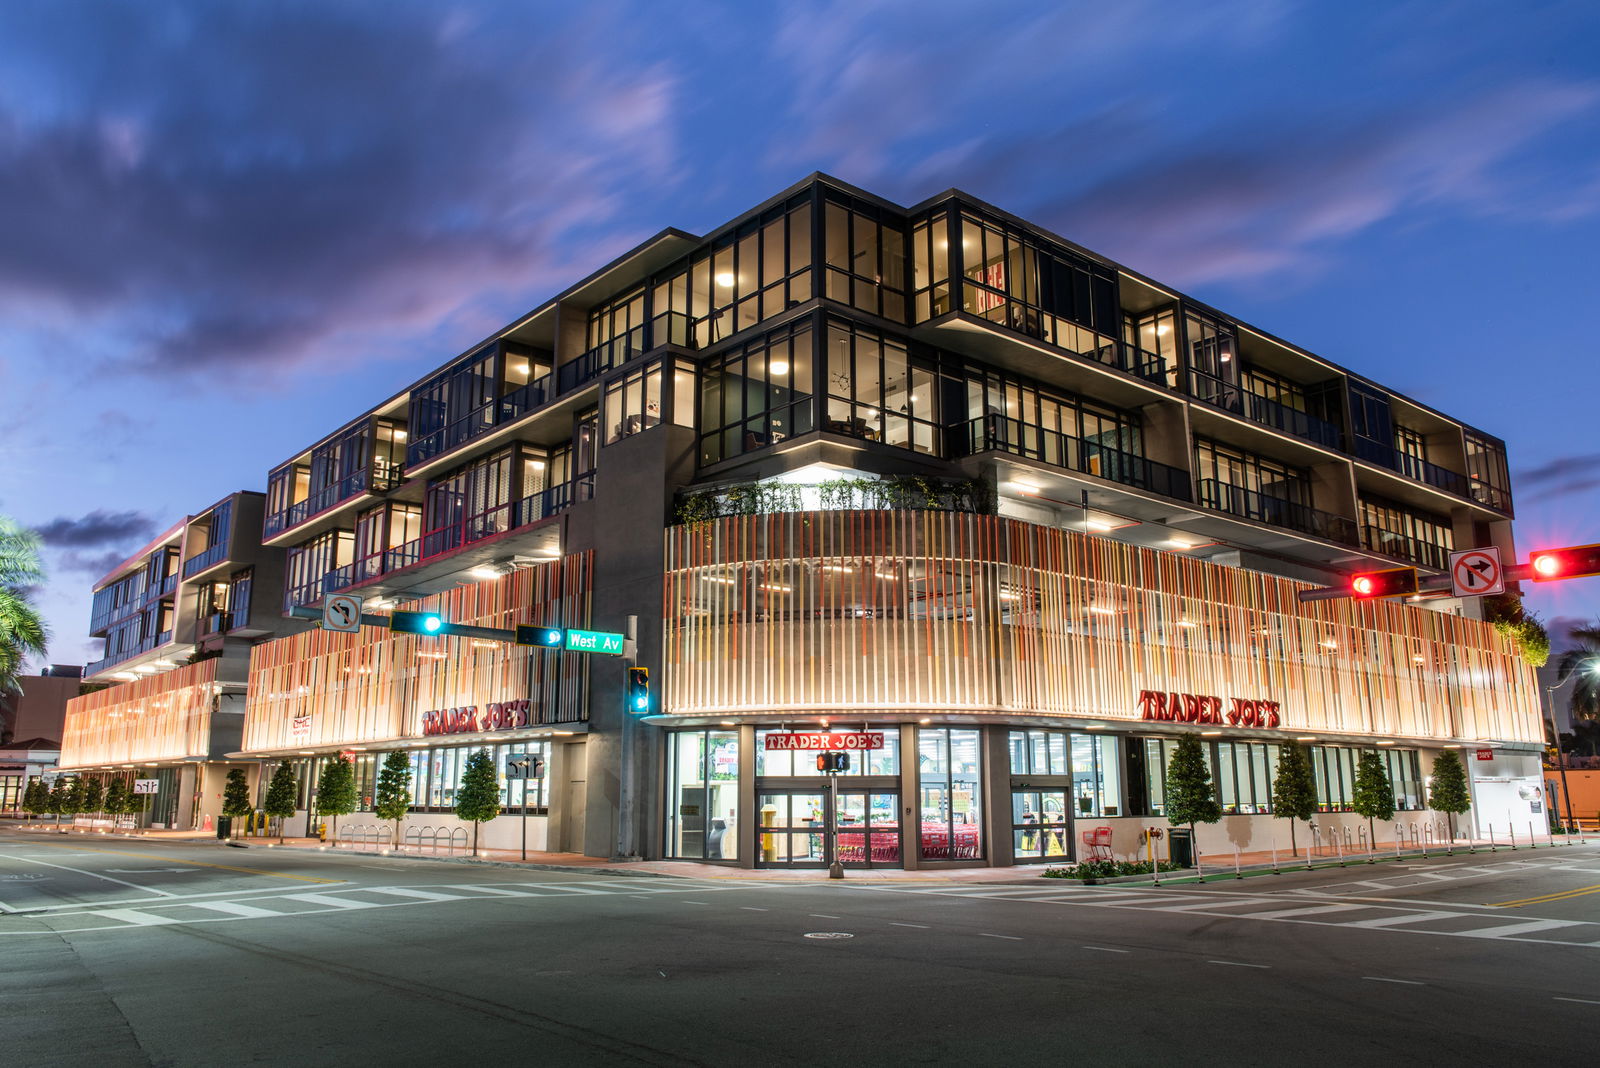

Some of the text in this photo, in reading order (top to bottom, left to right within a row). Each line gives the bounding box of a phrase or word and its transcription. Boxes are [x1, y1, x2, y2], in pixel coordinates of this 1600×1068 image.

[571, 633, 620, 650] West Av
[422, 698, 531, 736] TRADER JOE'S
[1138, 690, 1281, 728] TRADER JOE'S
[767, 734, 882, 749] TRADER JOE'S
